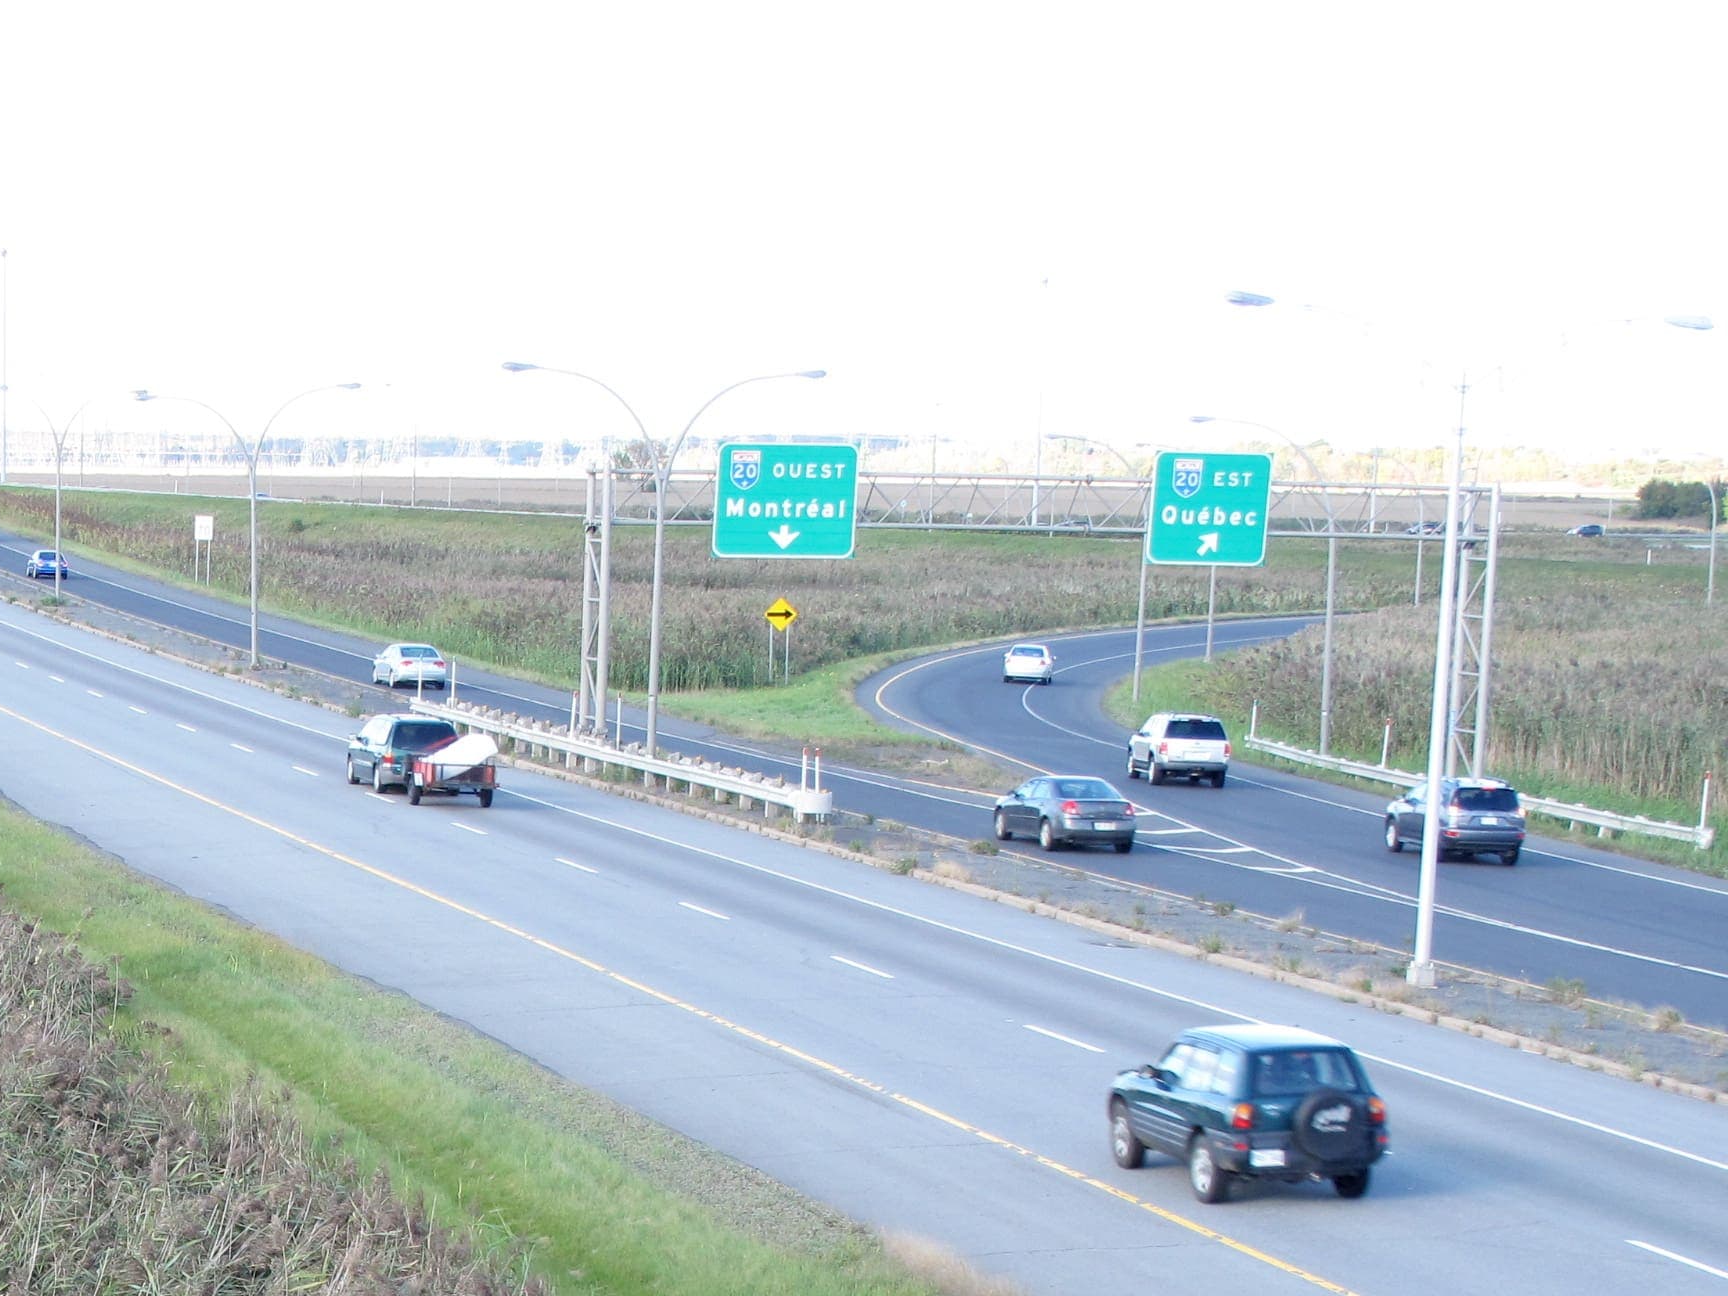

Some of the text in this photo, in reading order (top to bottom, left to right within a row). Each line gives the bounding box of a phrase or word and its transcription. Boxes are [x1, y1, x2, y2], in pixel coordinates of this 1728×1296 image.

[733, 463, 846, 479] 20 OUEST
[1175, 471, 1252, 487] 20 EST
[725, 497, 846, 518] Montréal
[1161, 505, 1257, 526] Québec
